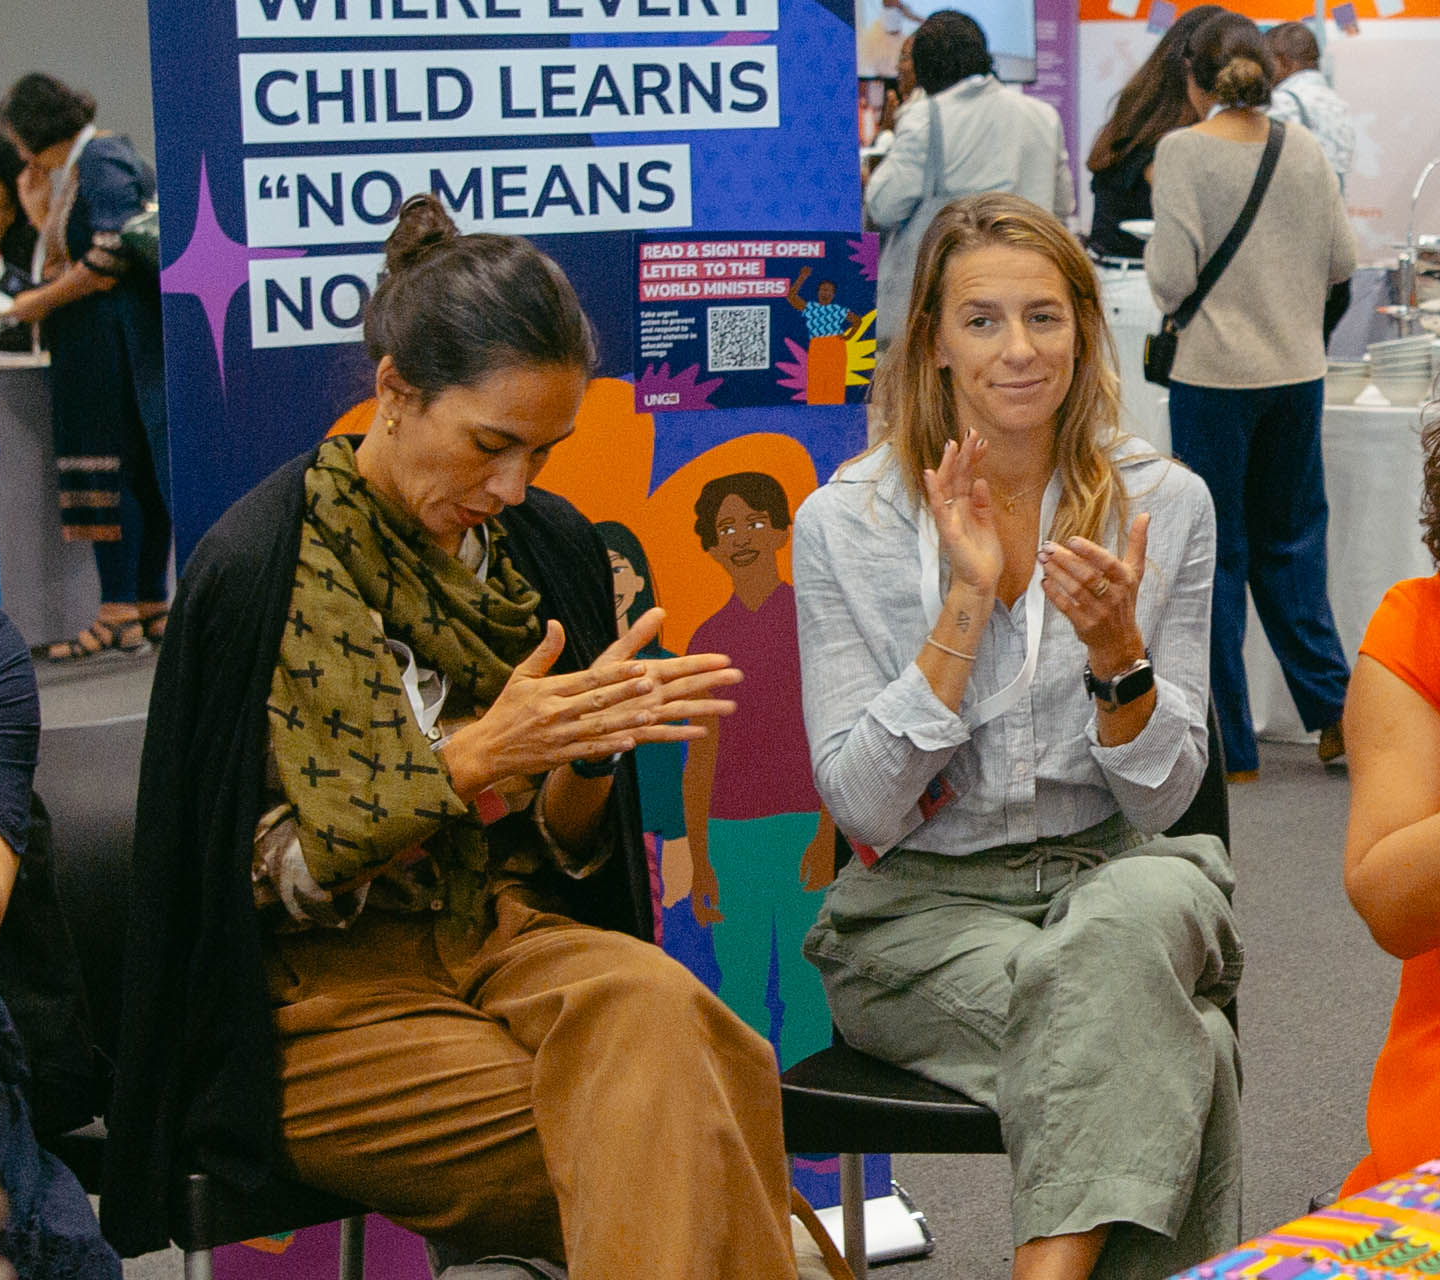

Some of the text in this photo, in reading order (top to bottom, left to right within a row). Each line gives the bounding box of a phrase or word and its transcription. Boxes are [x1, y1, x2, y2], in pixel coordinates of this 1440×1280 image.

[255, 61, 767, 125] CHILD LEARNS
[429, 159, 677, 221] MEANS
[642, 261, 760, 279] LETTER TO THE
[643, 242, 820, 259] READ & SIGN THE OPEN
[265, 272, 388, 333] NO
[643, 281, 786, 298] WORLD MINISTERS
